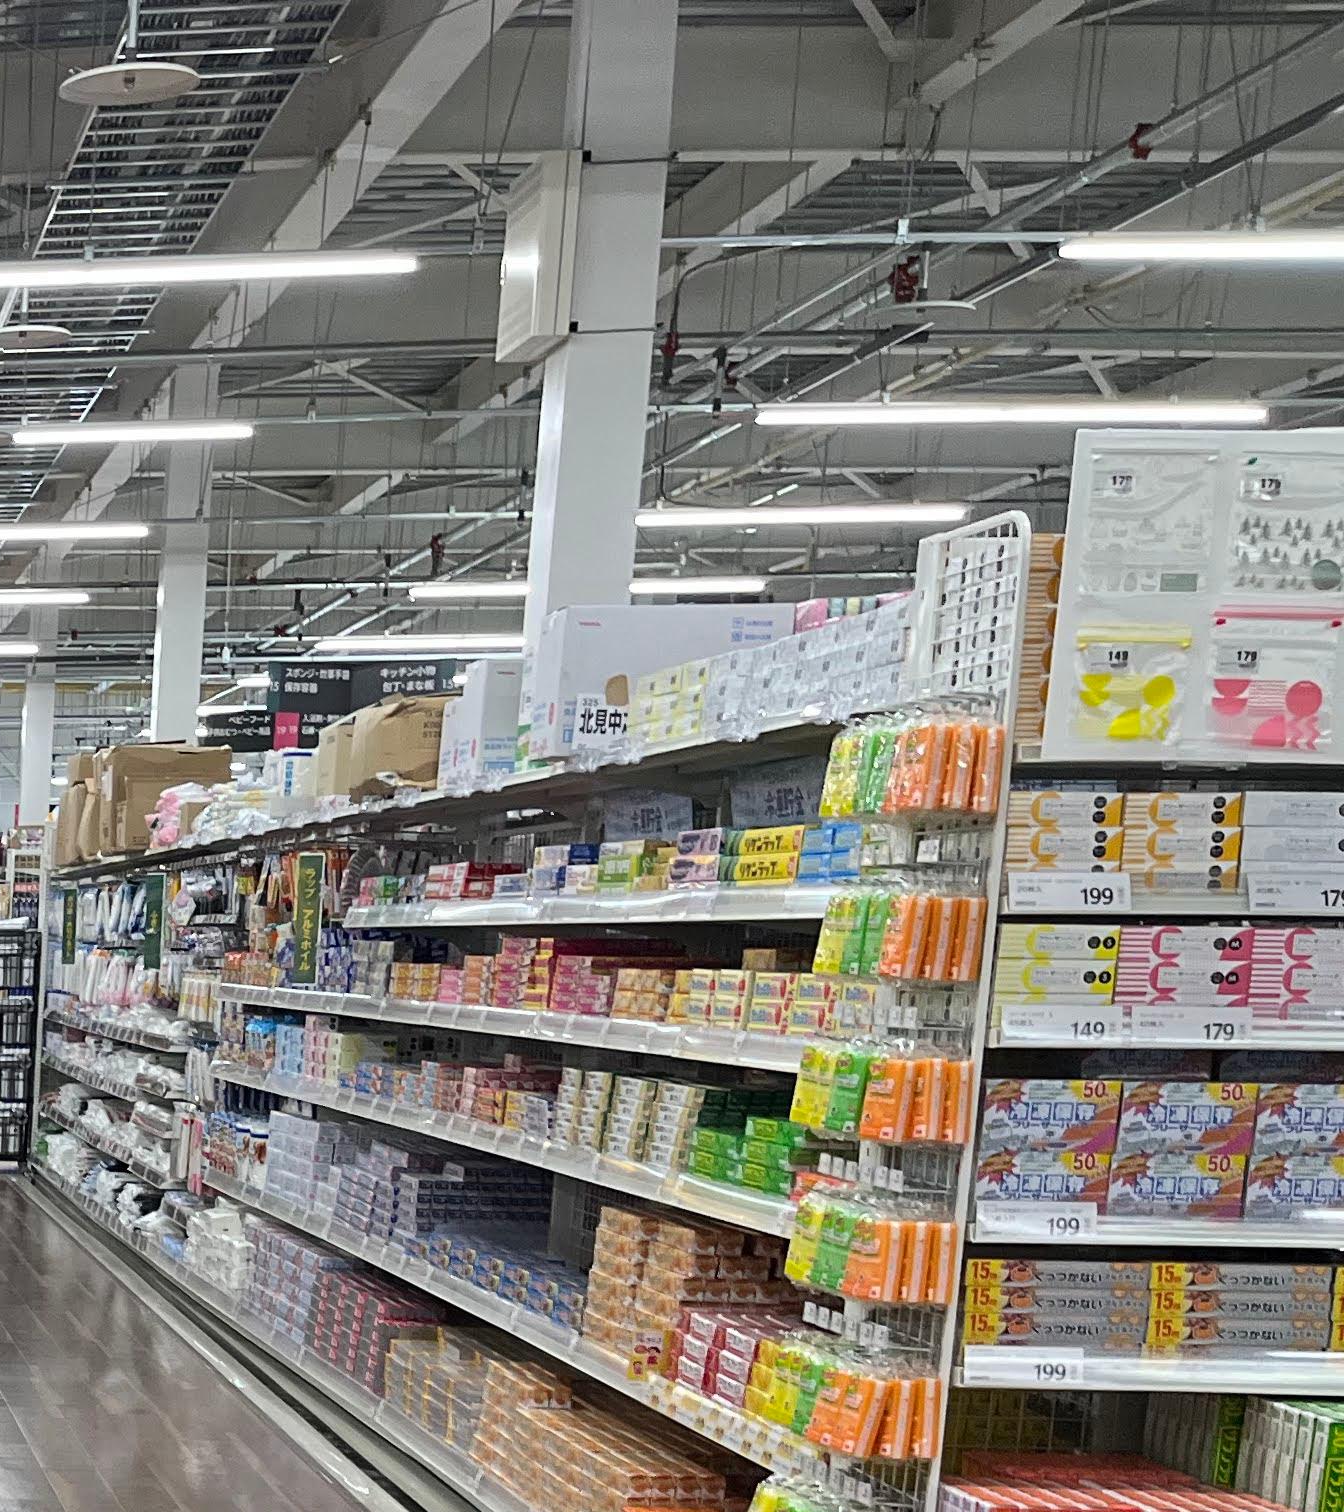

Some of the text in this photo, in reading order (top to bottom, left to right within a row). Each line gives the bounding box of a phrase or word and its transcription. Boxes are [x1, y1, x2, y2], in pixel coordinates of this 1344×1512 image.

[1080, 887, 1113, 905] 199
[1071, 1021, 1105, 1038] 149
[1203, 1023, 1235, 1040] 179
[1047, 1217, 1080, 1235] 199
[1034, 1363, 1066, 1381] 199
